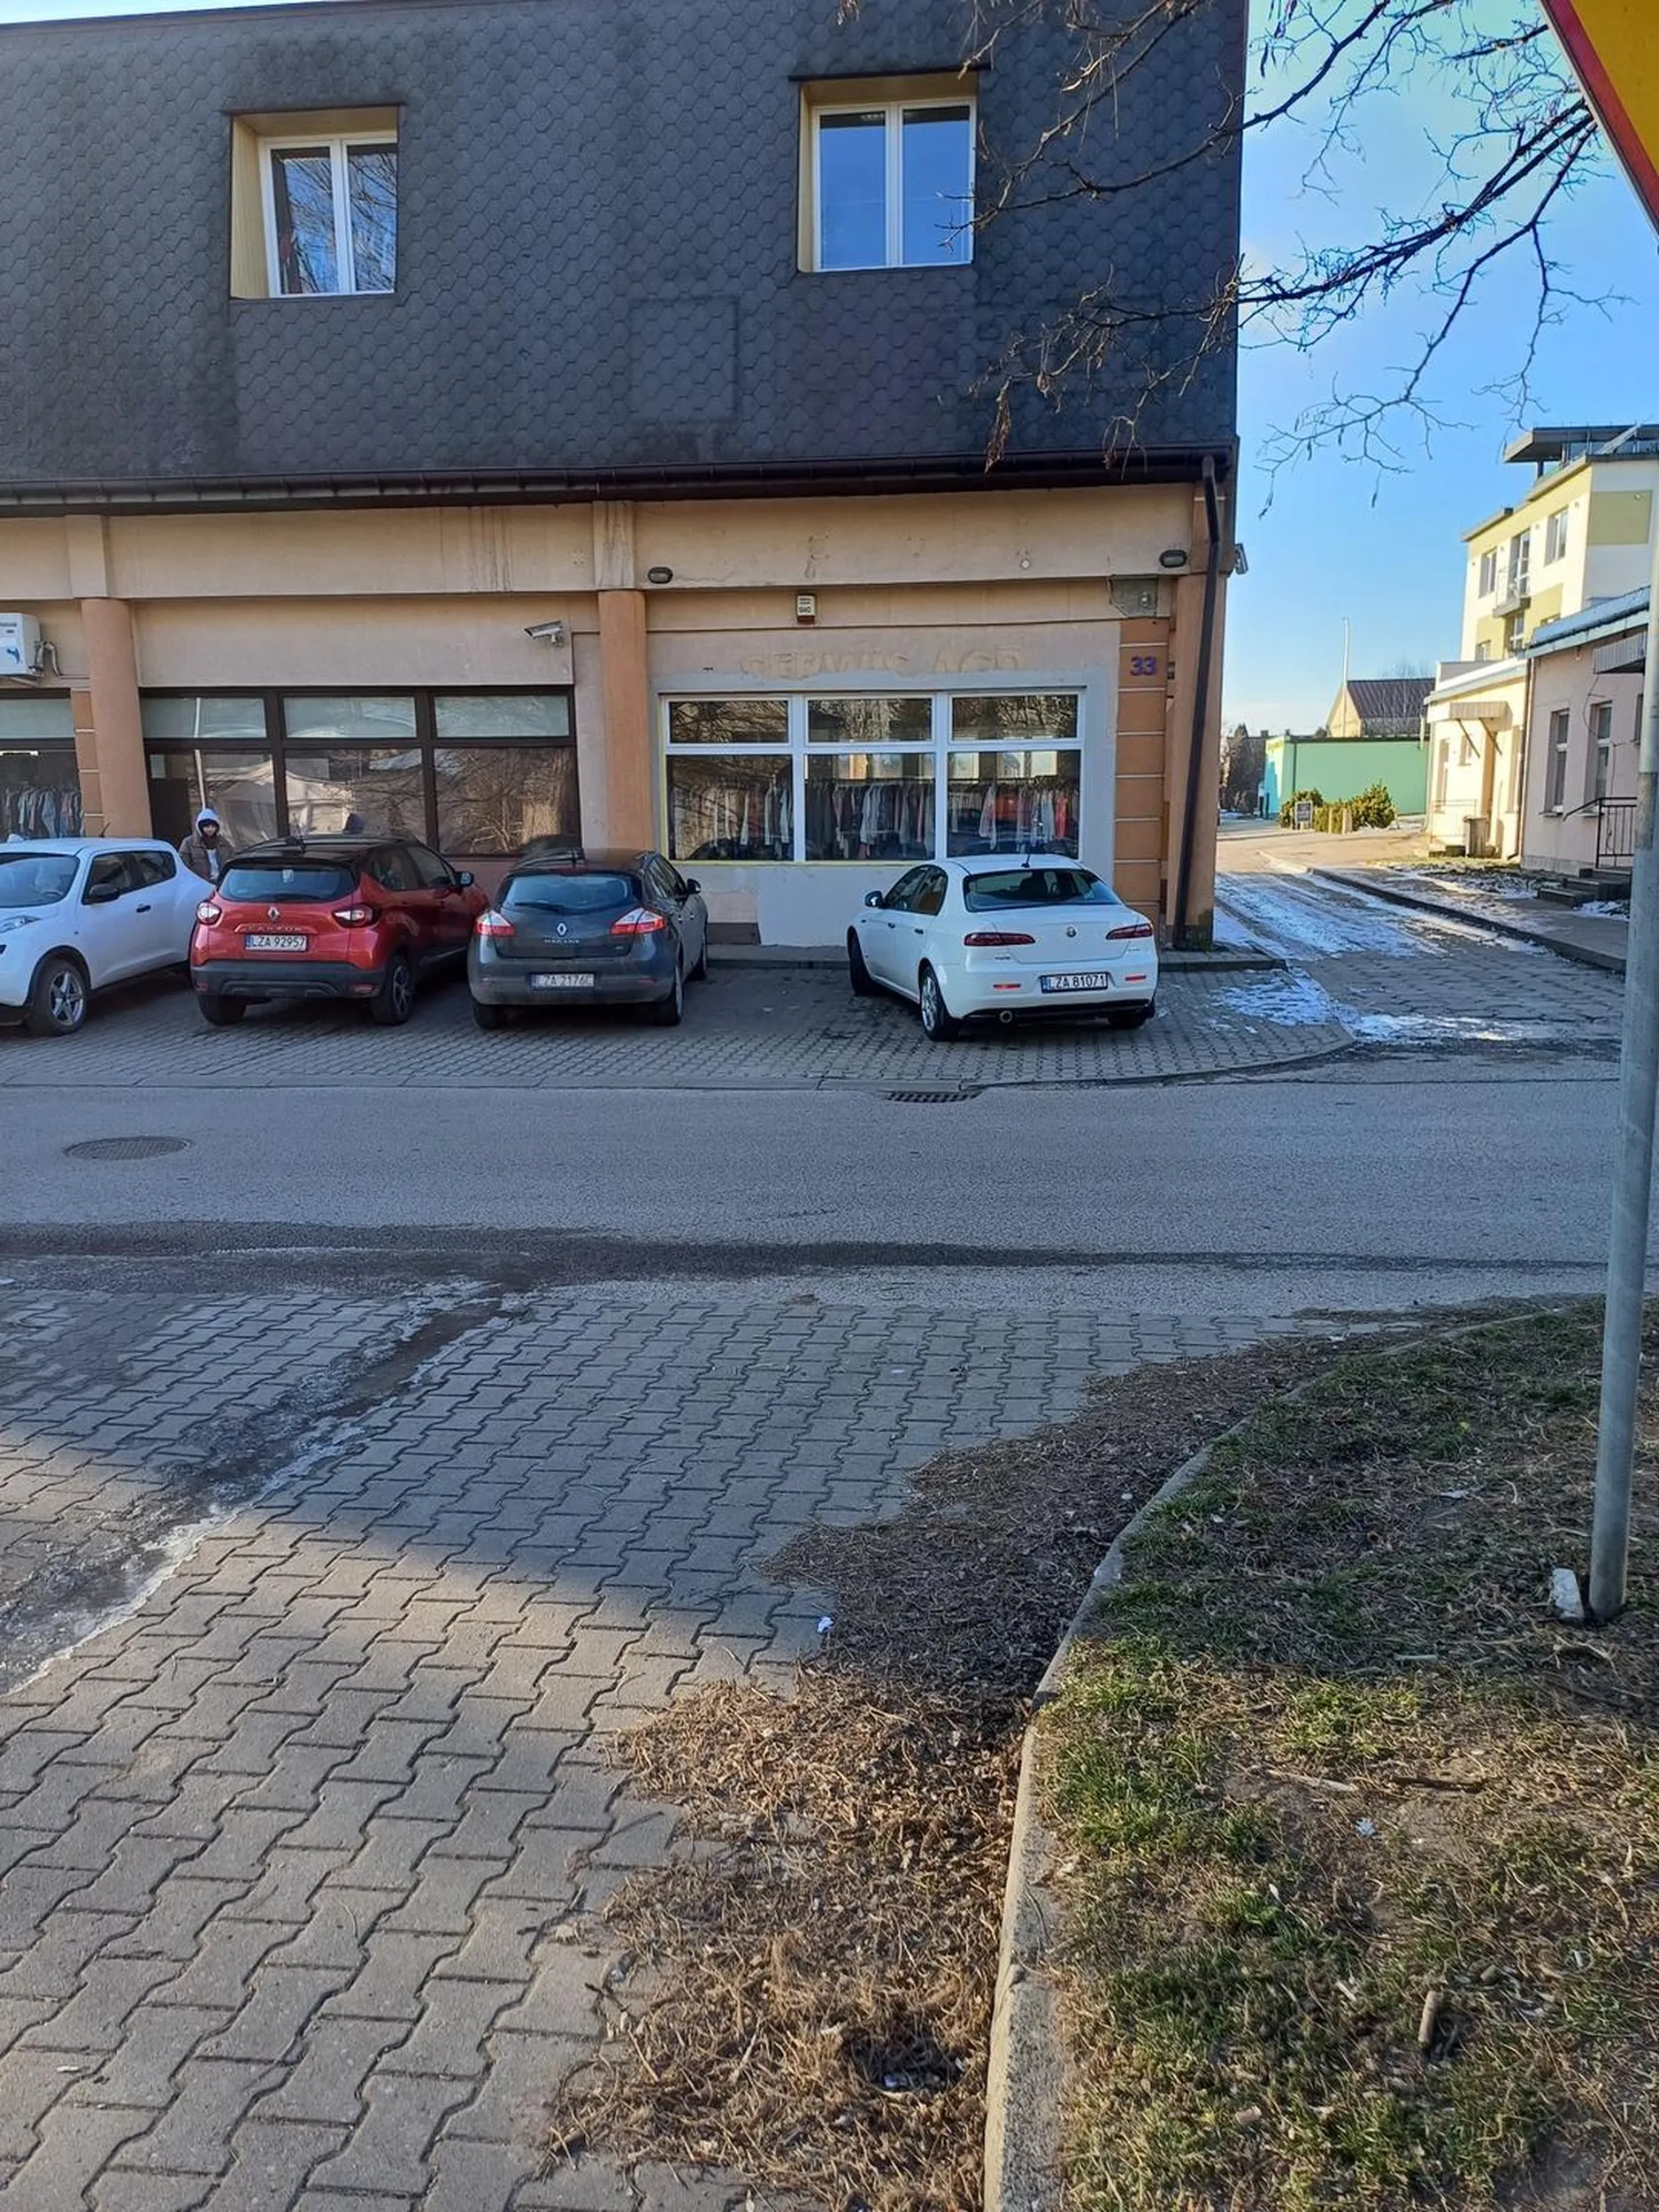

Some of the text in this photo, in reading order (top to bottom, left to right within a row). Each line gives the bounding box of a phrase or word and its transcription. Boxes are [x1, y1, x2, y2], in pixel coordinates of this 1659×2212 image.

[1130, 657, 1156, 676] 33
[252, 936, 305, 949] LZA 92957
[1048, 974, 1105, 989] LZA 81071
